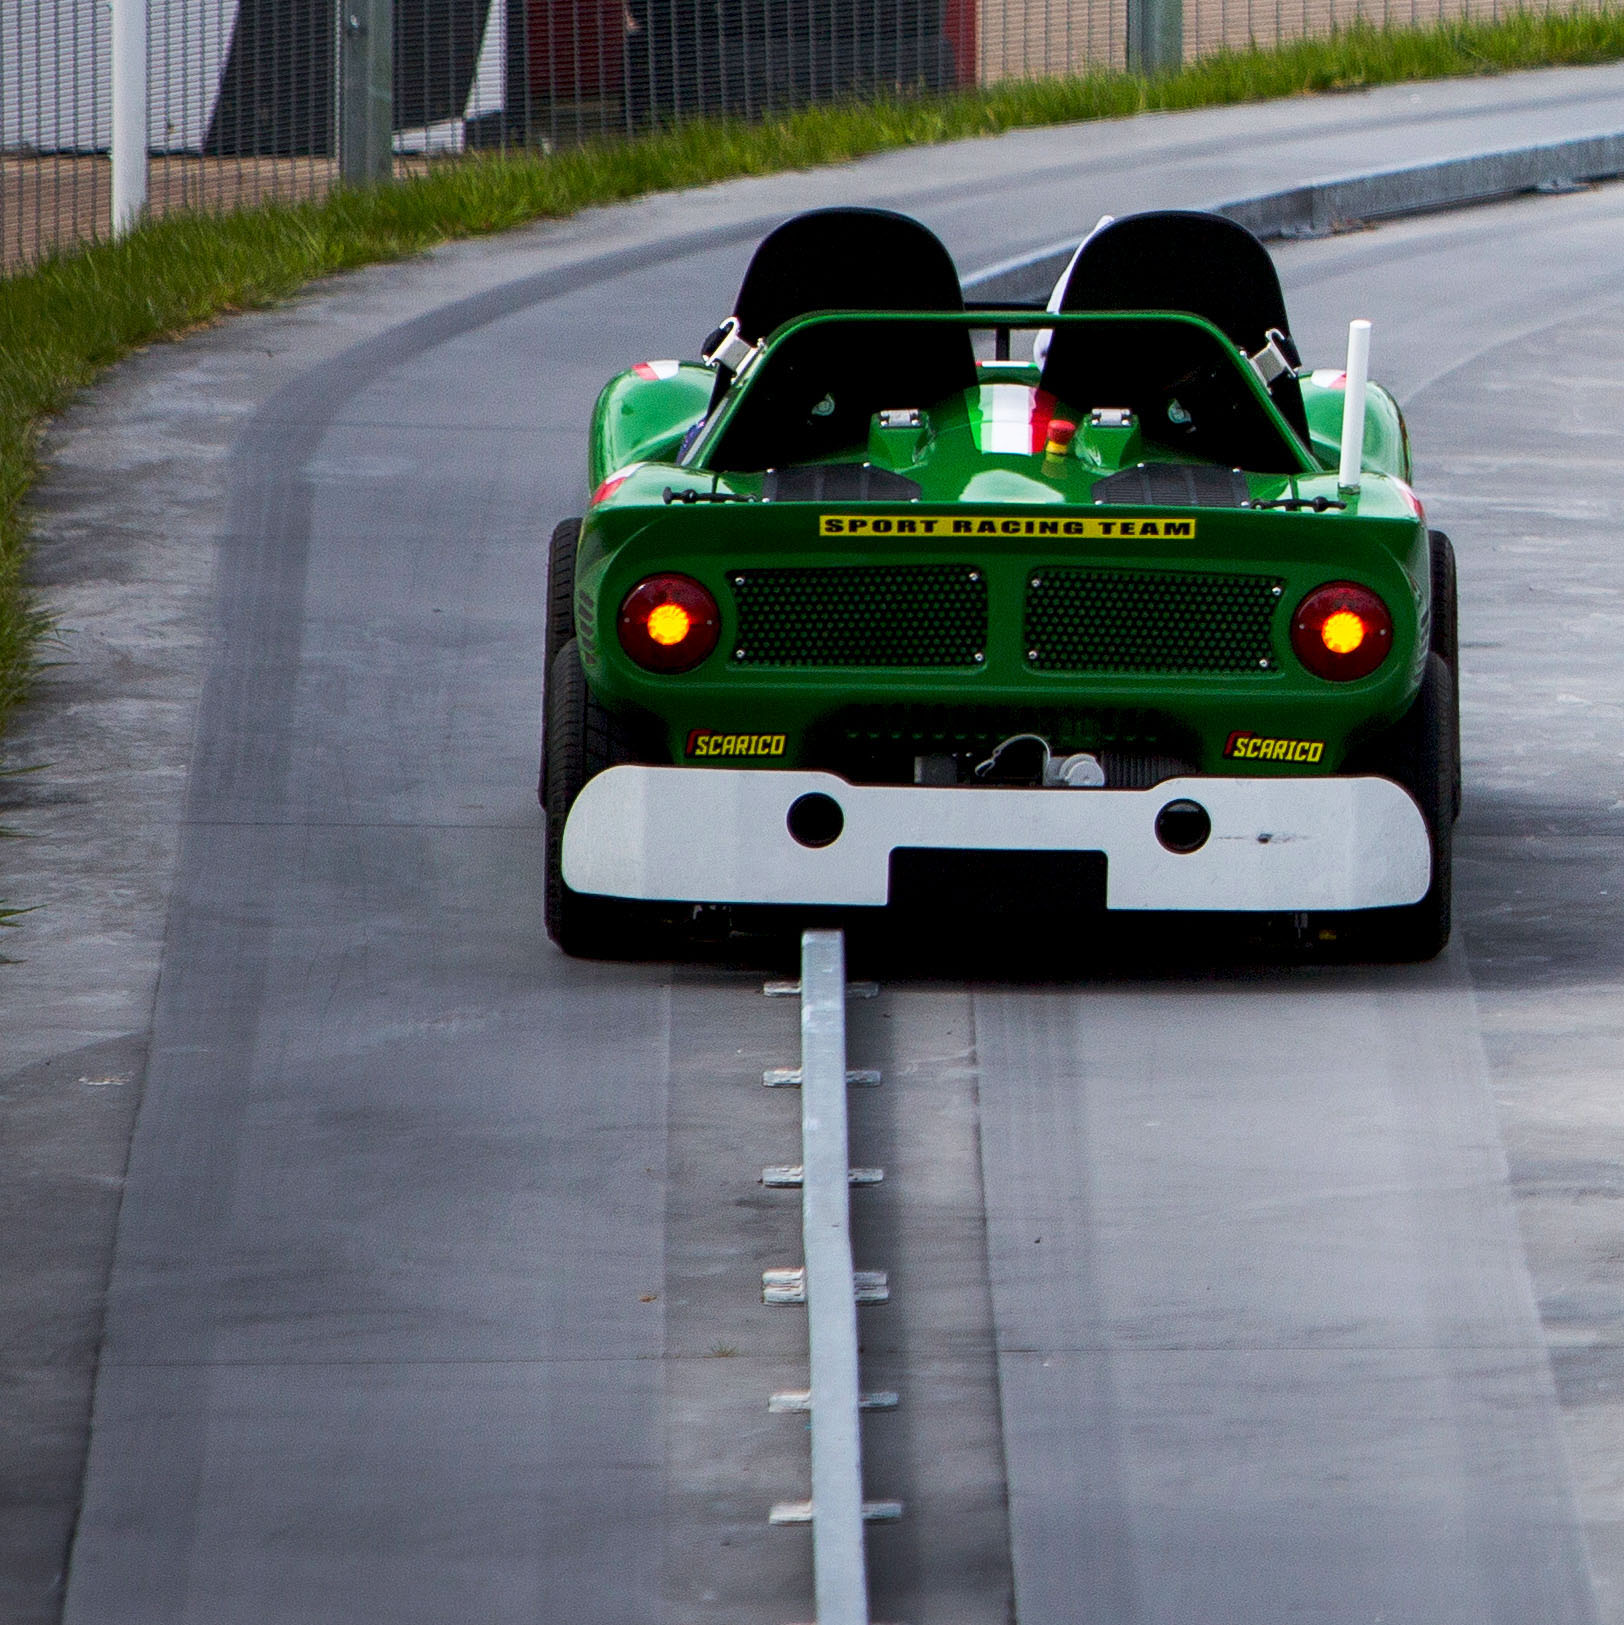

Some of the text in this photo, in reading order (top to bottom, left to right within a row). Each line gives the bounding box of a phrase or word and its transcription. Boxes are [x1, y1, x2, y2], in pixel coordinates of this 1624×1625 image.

[824, 519, 1192, 536] SPORT RACING TEAM
[695, 735, 786, 756] SCARICO
[1233, 737, 1323, 762] SCARICO
